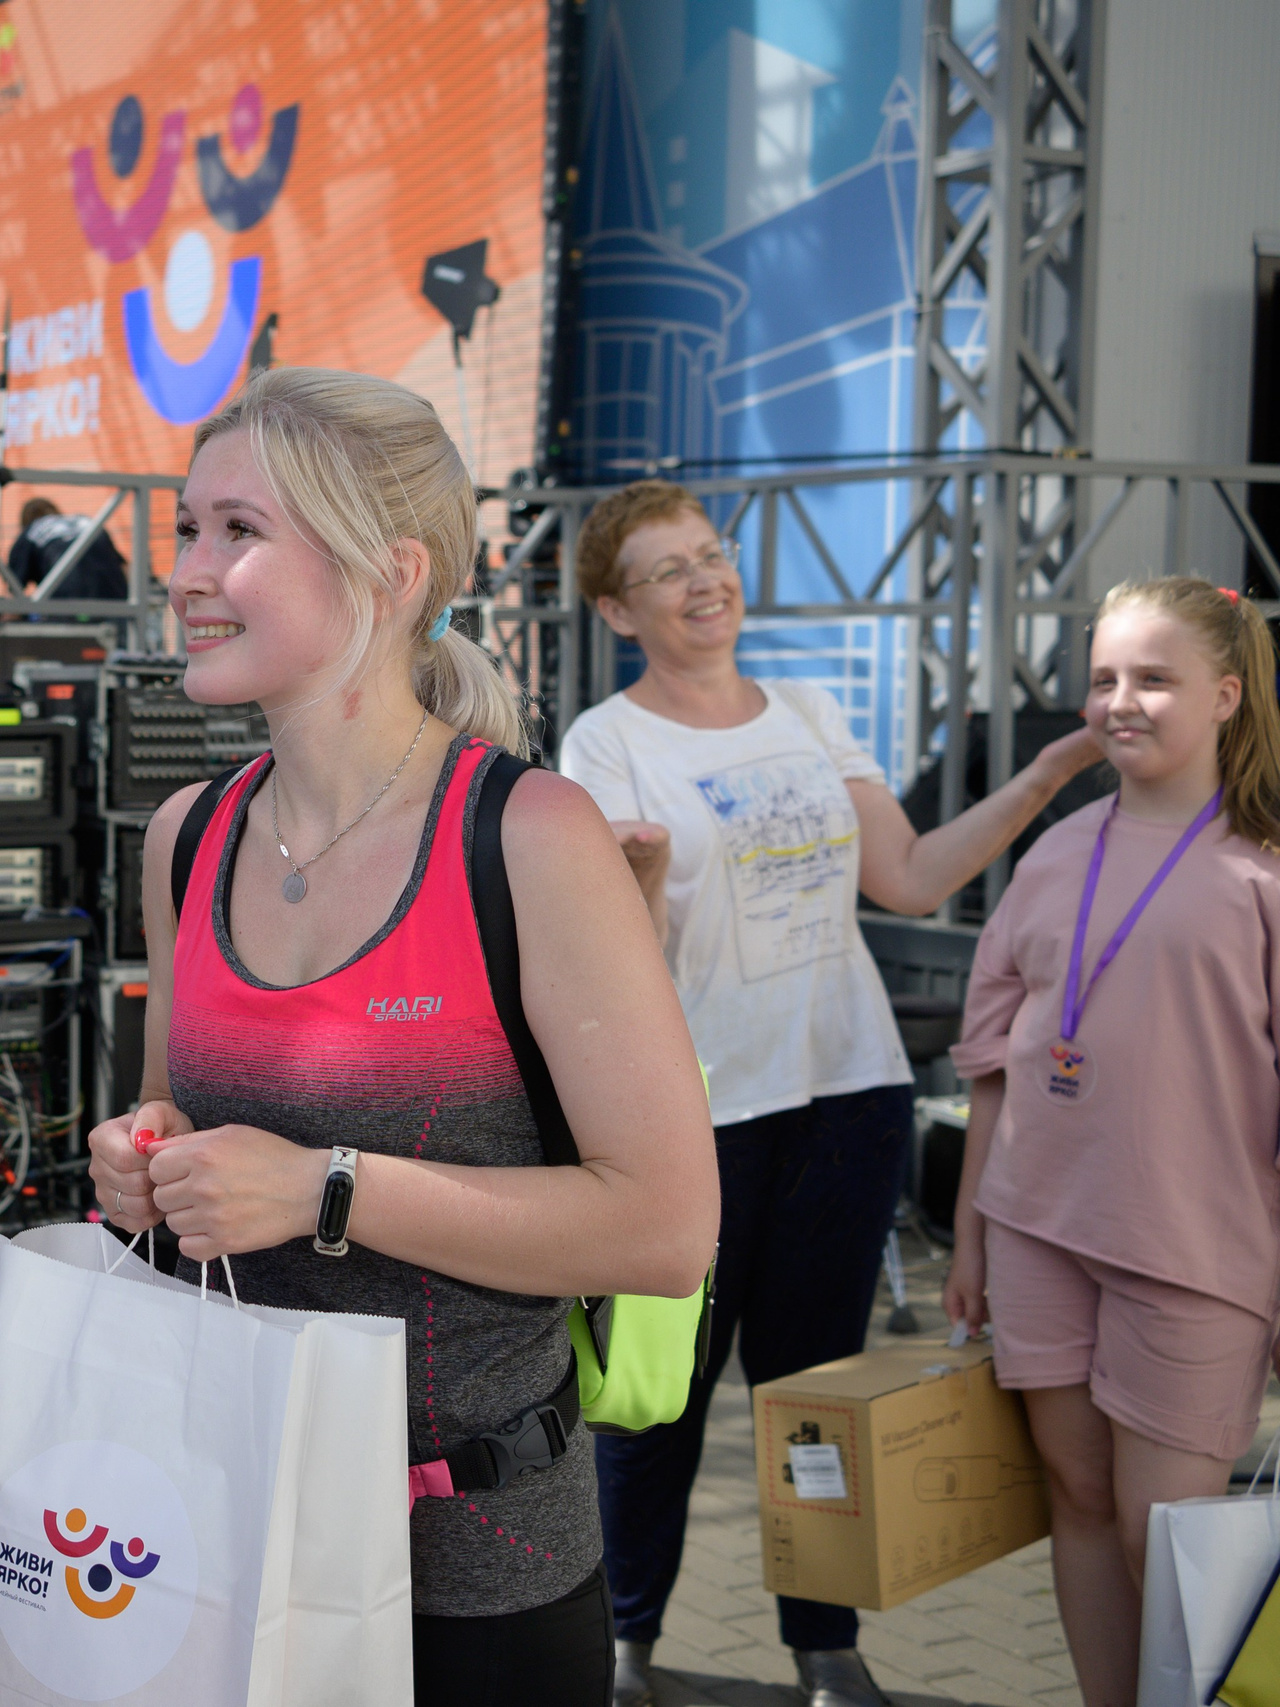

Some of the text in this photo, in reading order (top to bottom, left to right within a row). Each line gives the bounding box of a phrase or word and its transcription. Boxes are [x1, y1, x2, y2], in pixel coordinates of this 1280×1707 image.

[366, 996, 443, 1013] KARI
[374, 1012, 430, 1022] SPORT
[18, 1597, 47, 1612] ФЕСТИВАЛЬ
